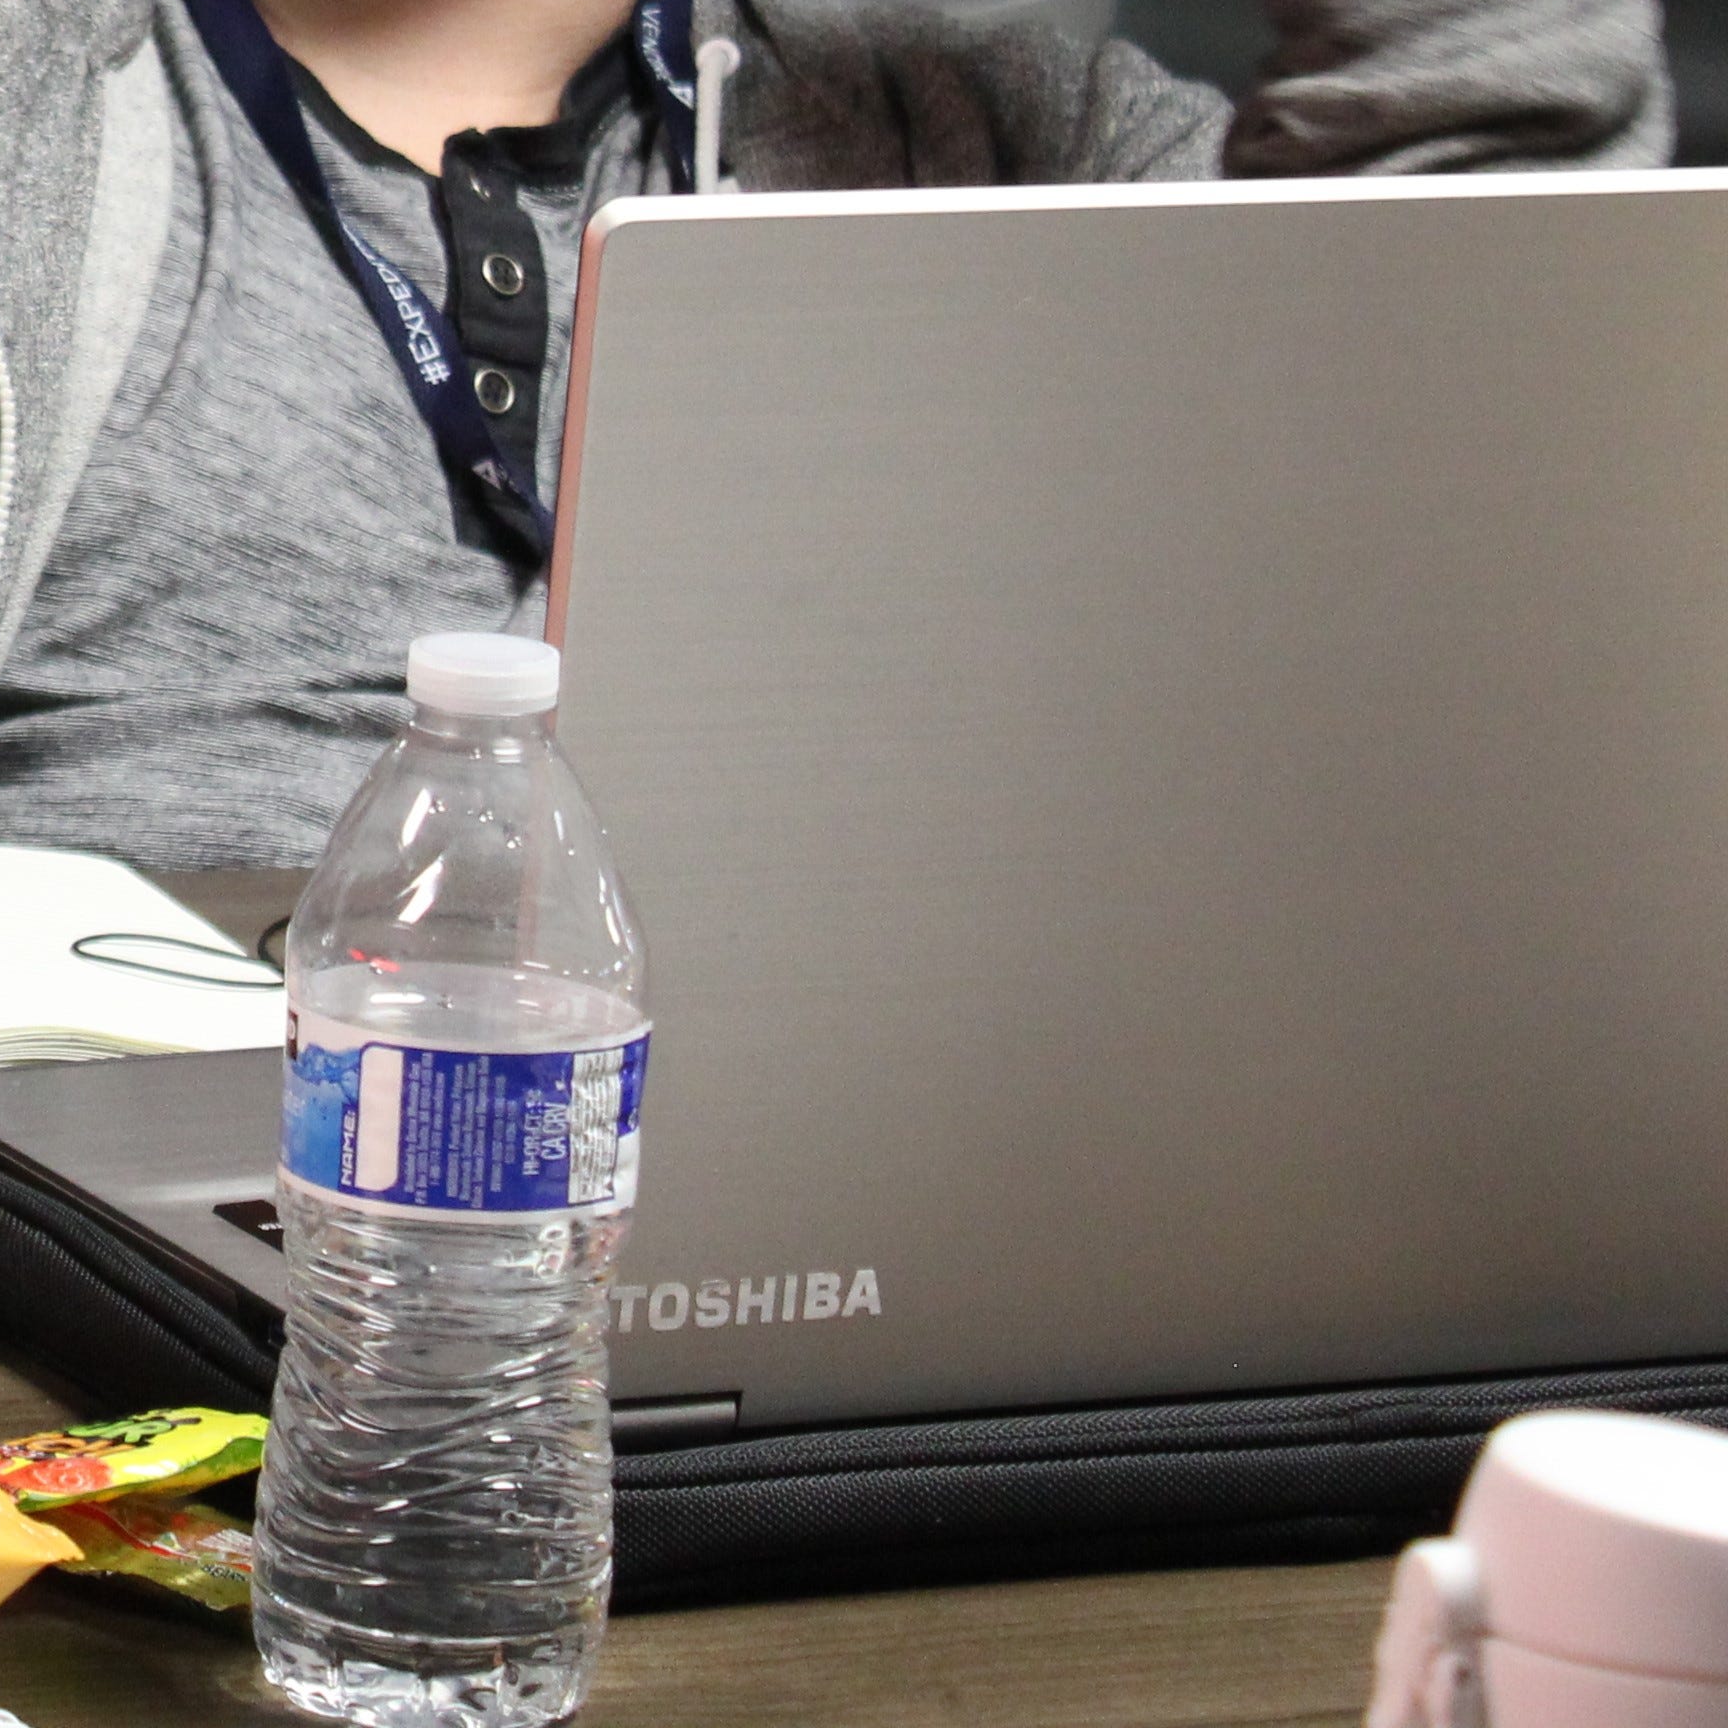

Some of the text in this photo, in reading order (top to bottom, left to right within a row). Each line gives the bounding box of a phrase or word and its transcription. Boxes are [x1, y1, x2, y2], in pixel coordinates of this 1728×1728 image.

[341, 1110, 357, 1186] NAME:
[540, 1135, 567, 1161] CA
[609, 1268, 882, 1333] TOSHIBA
